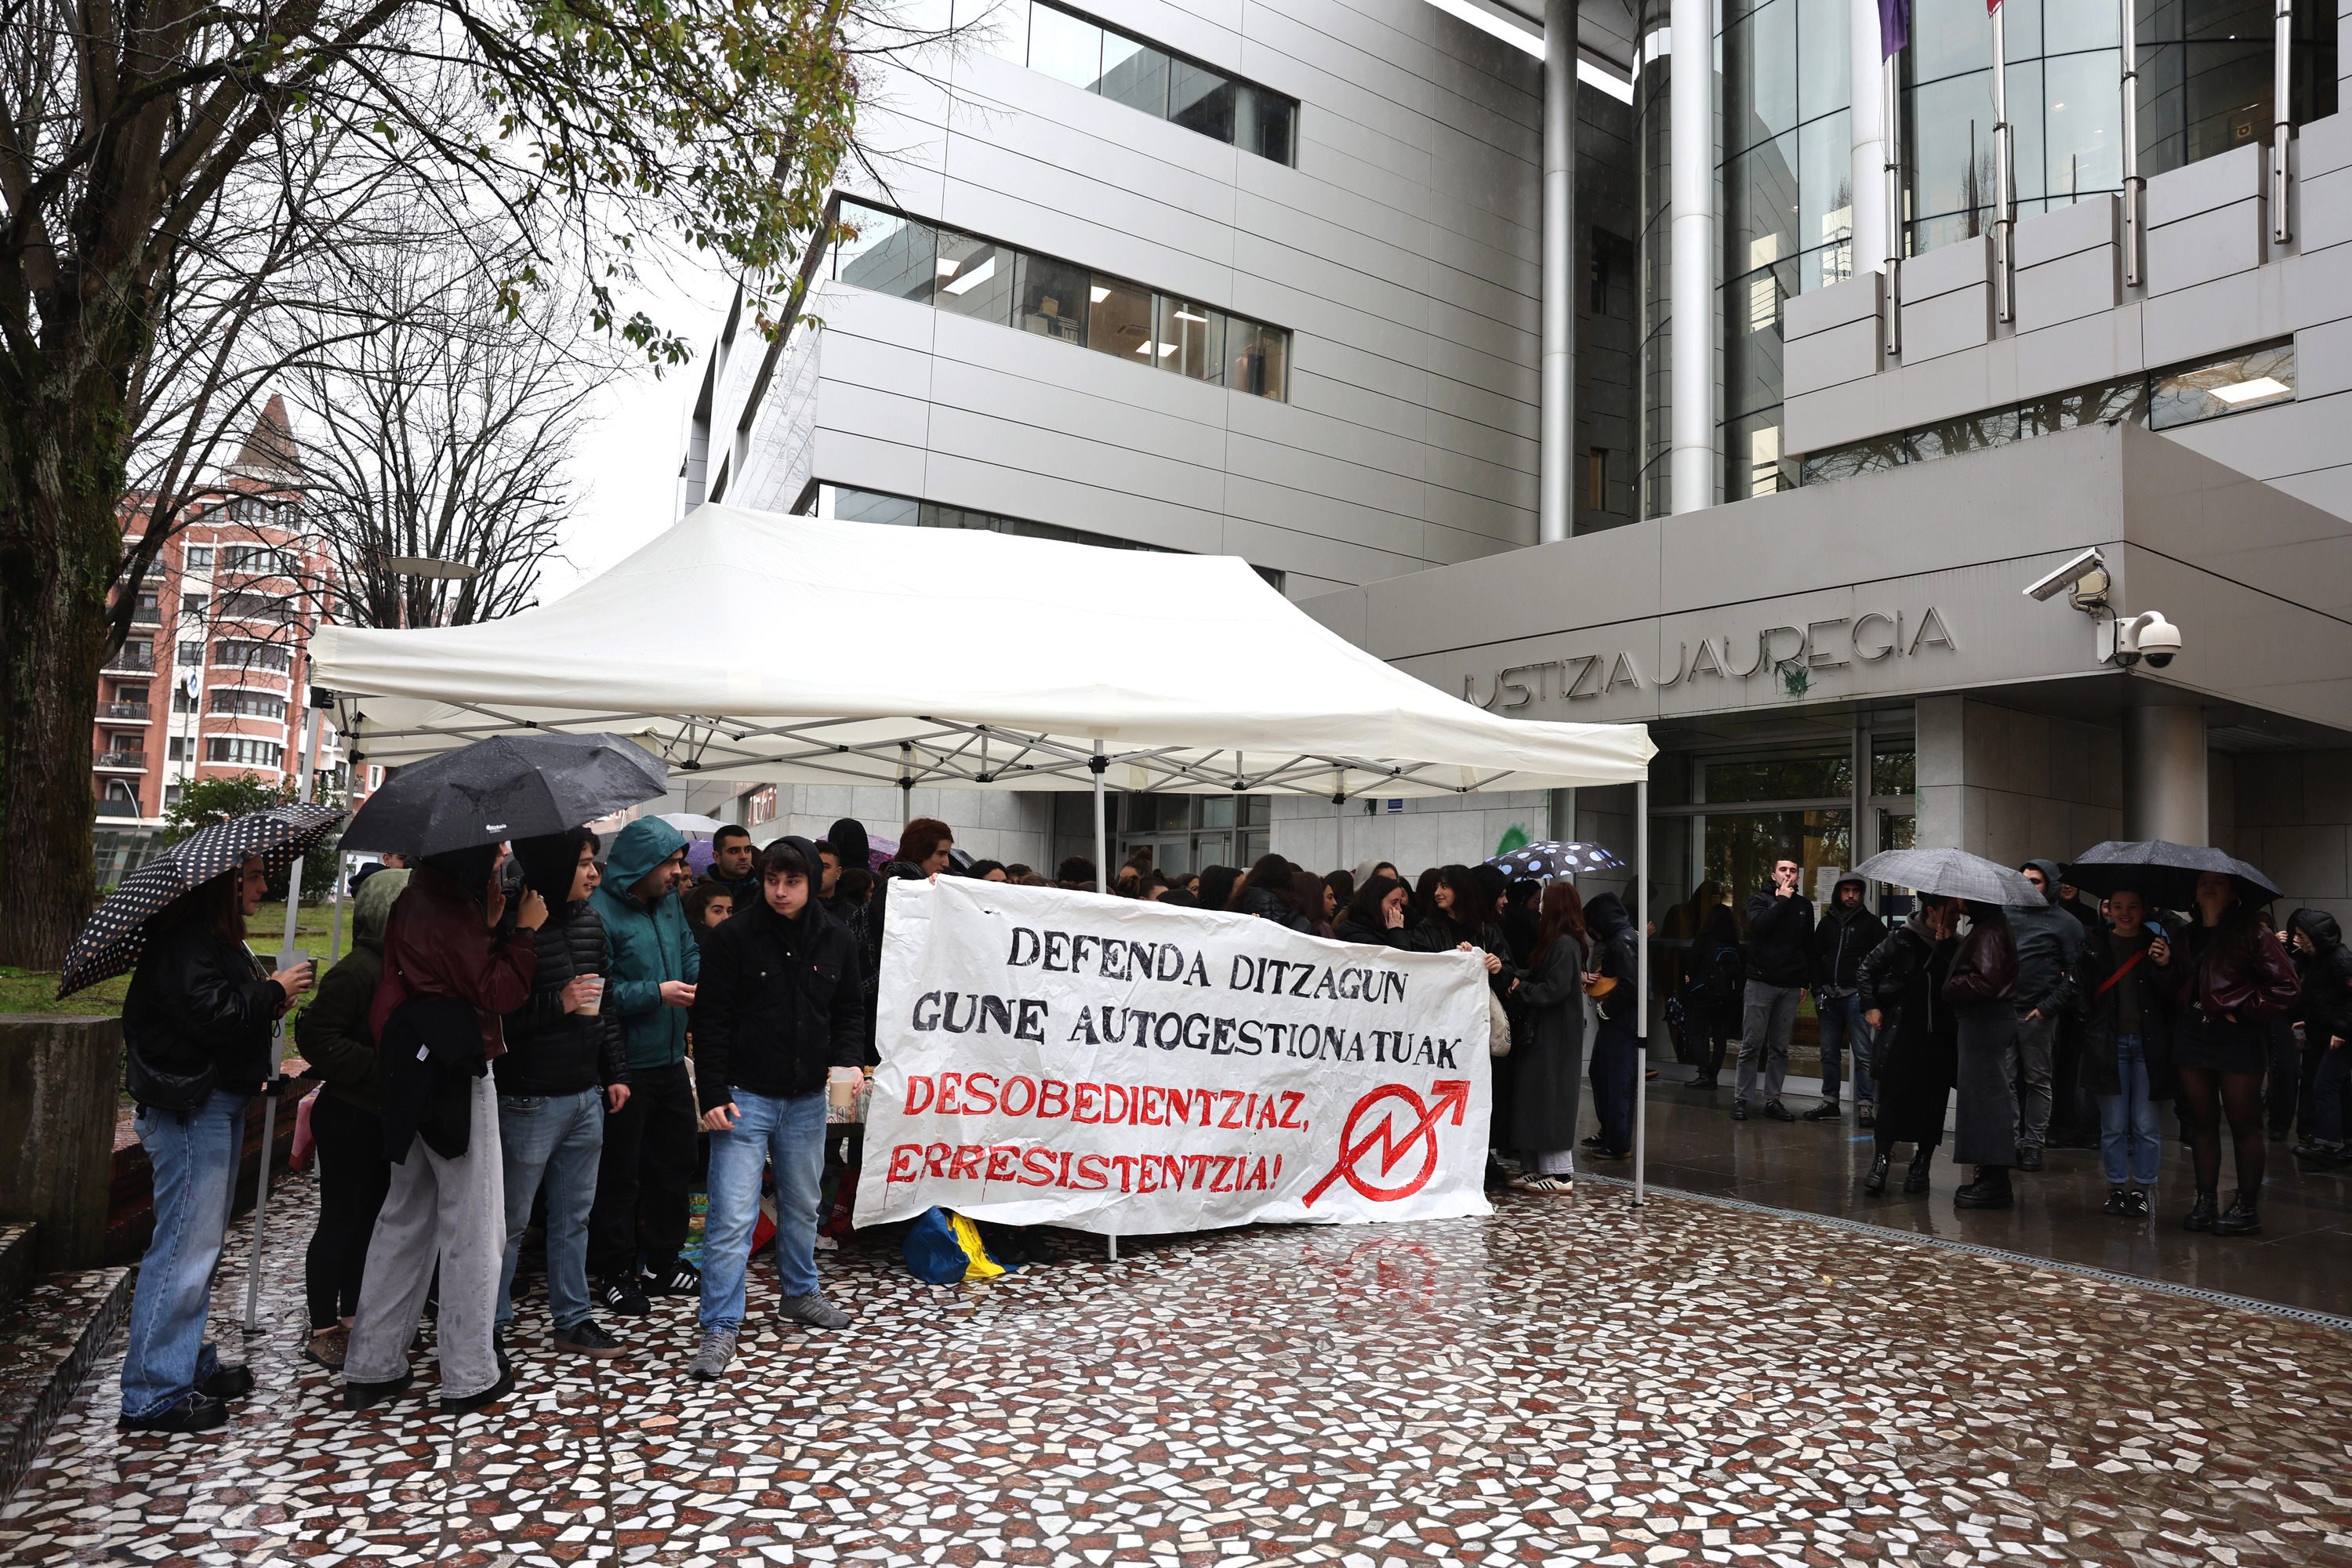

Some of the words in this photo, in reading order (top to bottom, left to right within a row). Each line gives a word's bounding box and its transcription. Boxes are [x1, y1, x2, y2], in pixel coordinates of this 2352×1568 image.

[1650, 605, 1956, 687] JAUREGIA
[1007, 927, 1211, 987] DEFENDA
[1229, 954, 1408, 1004] DITZAGUN
[913, 990, 1048, 1045] GUNE
[1067, 1005, 1462, 1070] AUTOGESTIONATUAK
[902, 1072, 1309, 1133] DESOBEDIENTZIAZ,
[886, 1142, 1283, 1193] ERRESISTENTZIA!
